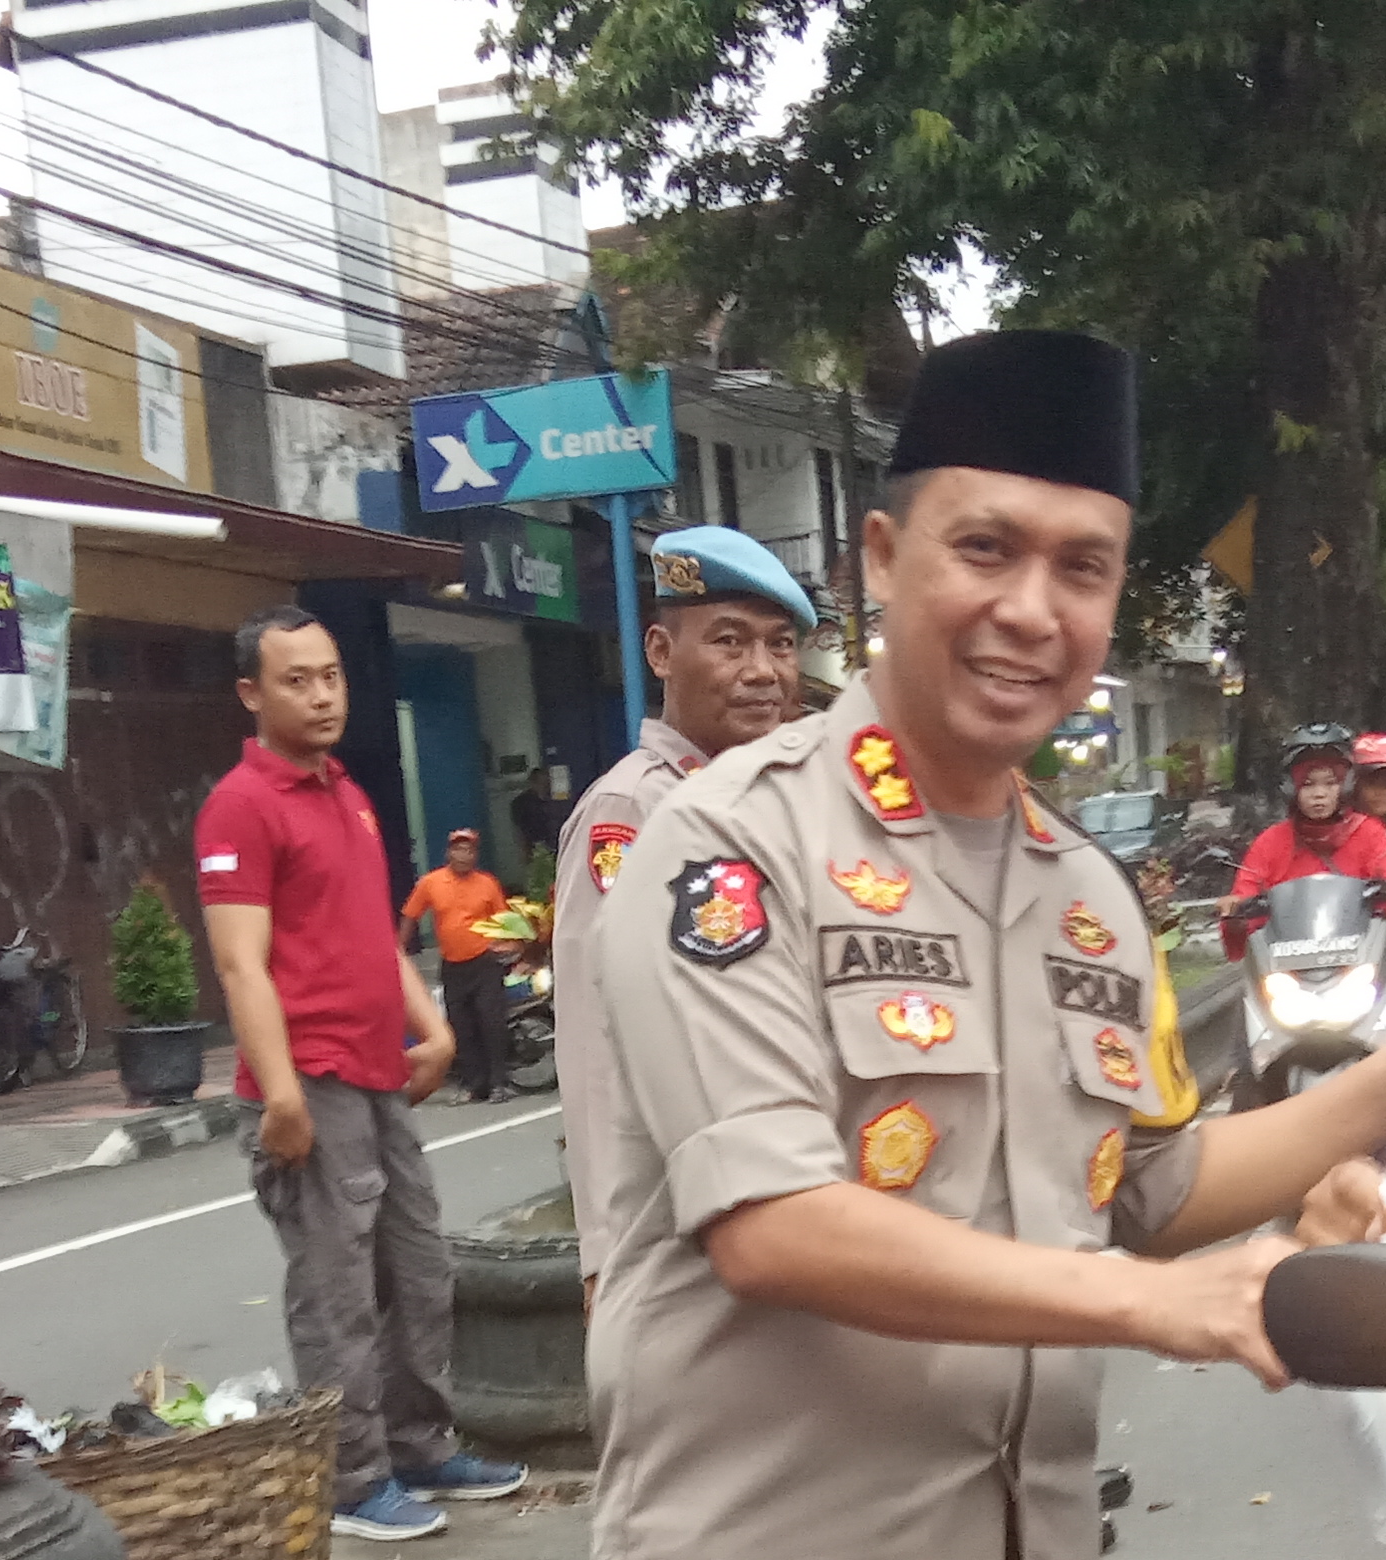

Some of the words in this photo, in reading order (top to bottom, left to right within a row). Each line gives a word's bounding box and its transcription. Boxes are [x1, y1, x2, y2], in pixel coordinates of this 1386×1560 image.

[427, 408, 518, 494] XL
[539, 423, 658, 461] Center
[837, 933, 953, 978] ARIES
